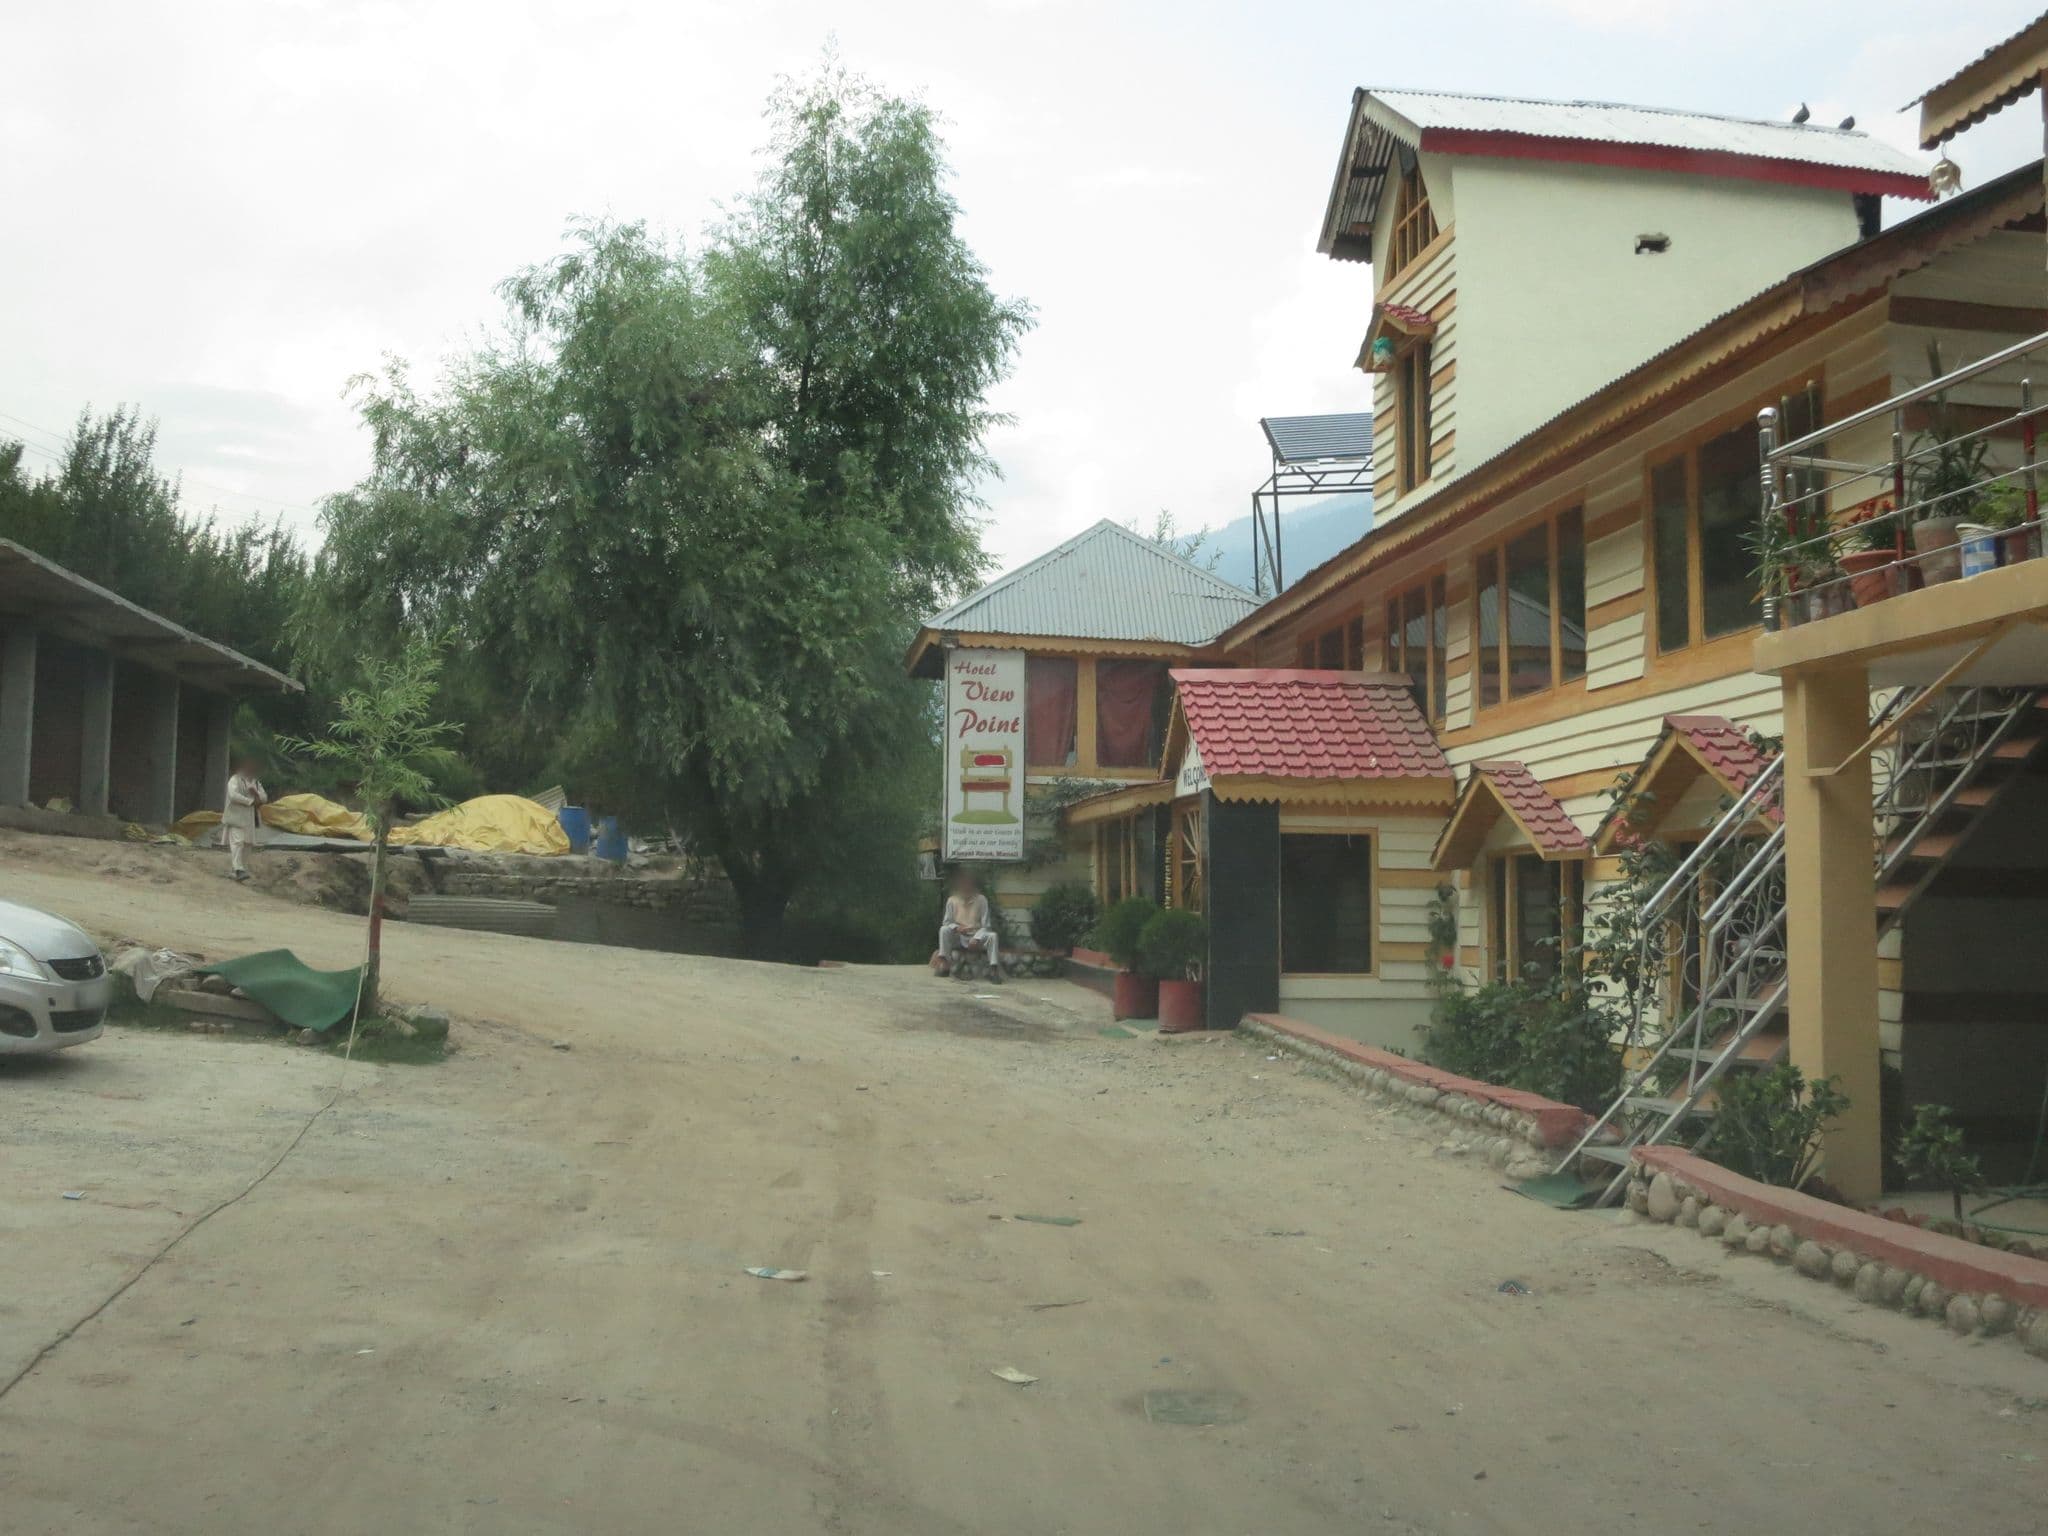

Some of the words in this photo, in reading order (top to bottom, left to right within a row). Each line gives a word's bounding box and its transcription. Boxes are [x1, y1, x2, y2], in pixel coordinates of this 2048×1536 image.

[954, 661, 997, 675] Hotel
[960, 680, 1015, 701] View
[954, 708, 1020, 738] Point
